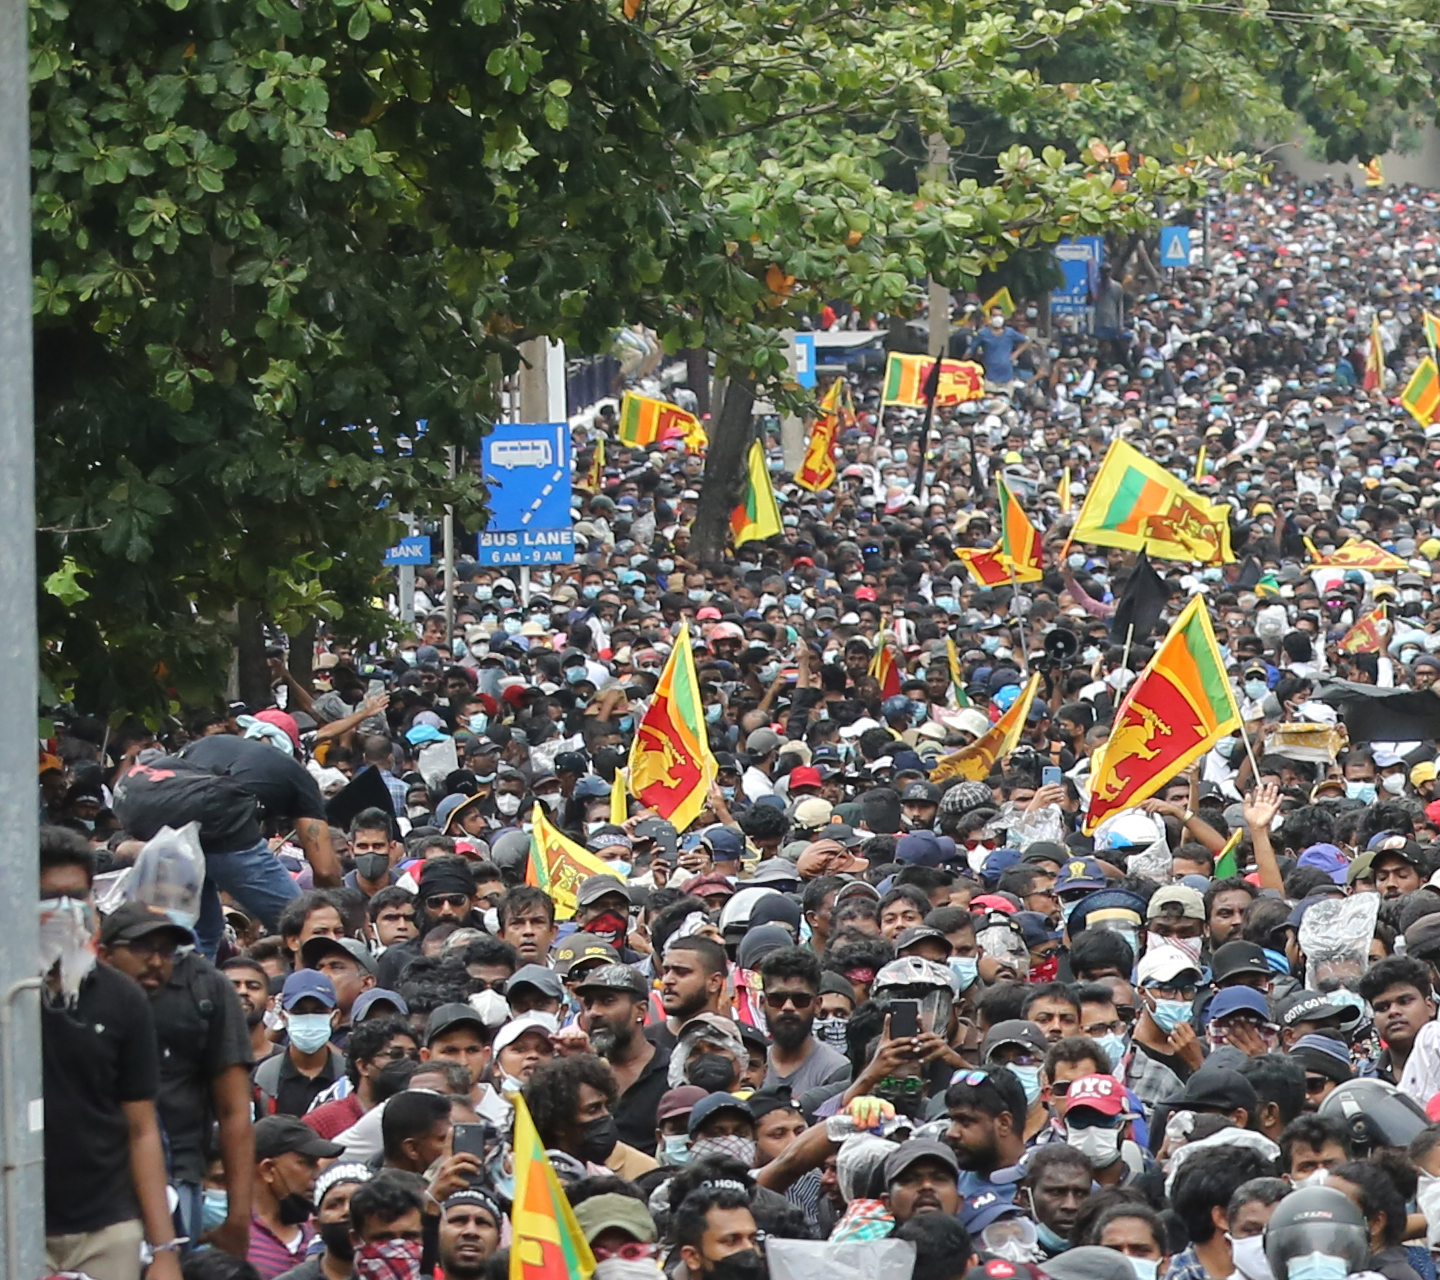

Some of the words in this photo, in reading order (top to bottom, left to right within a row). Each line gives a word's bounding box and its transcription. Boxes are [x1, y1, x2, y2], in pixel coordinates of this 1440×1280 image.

[481, 531, 518, 547] BUS
[524, 531, 572, 545] LANE
[391, 544, 423, 557] BANK
[491, 551, 500, 562] 6
[503, 552, 521, 562] AM
[533, 551, 541, 561] 9
[544, 551, 562, 561] AM
[1283, 1003, 1306, 1024] GOTA
[1304, 998, 1319, 1010] GO
[1070, 1077, 1113, 1098] NYC
